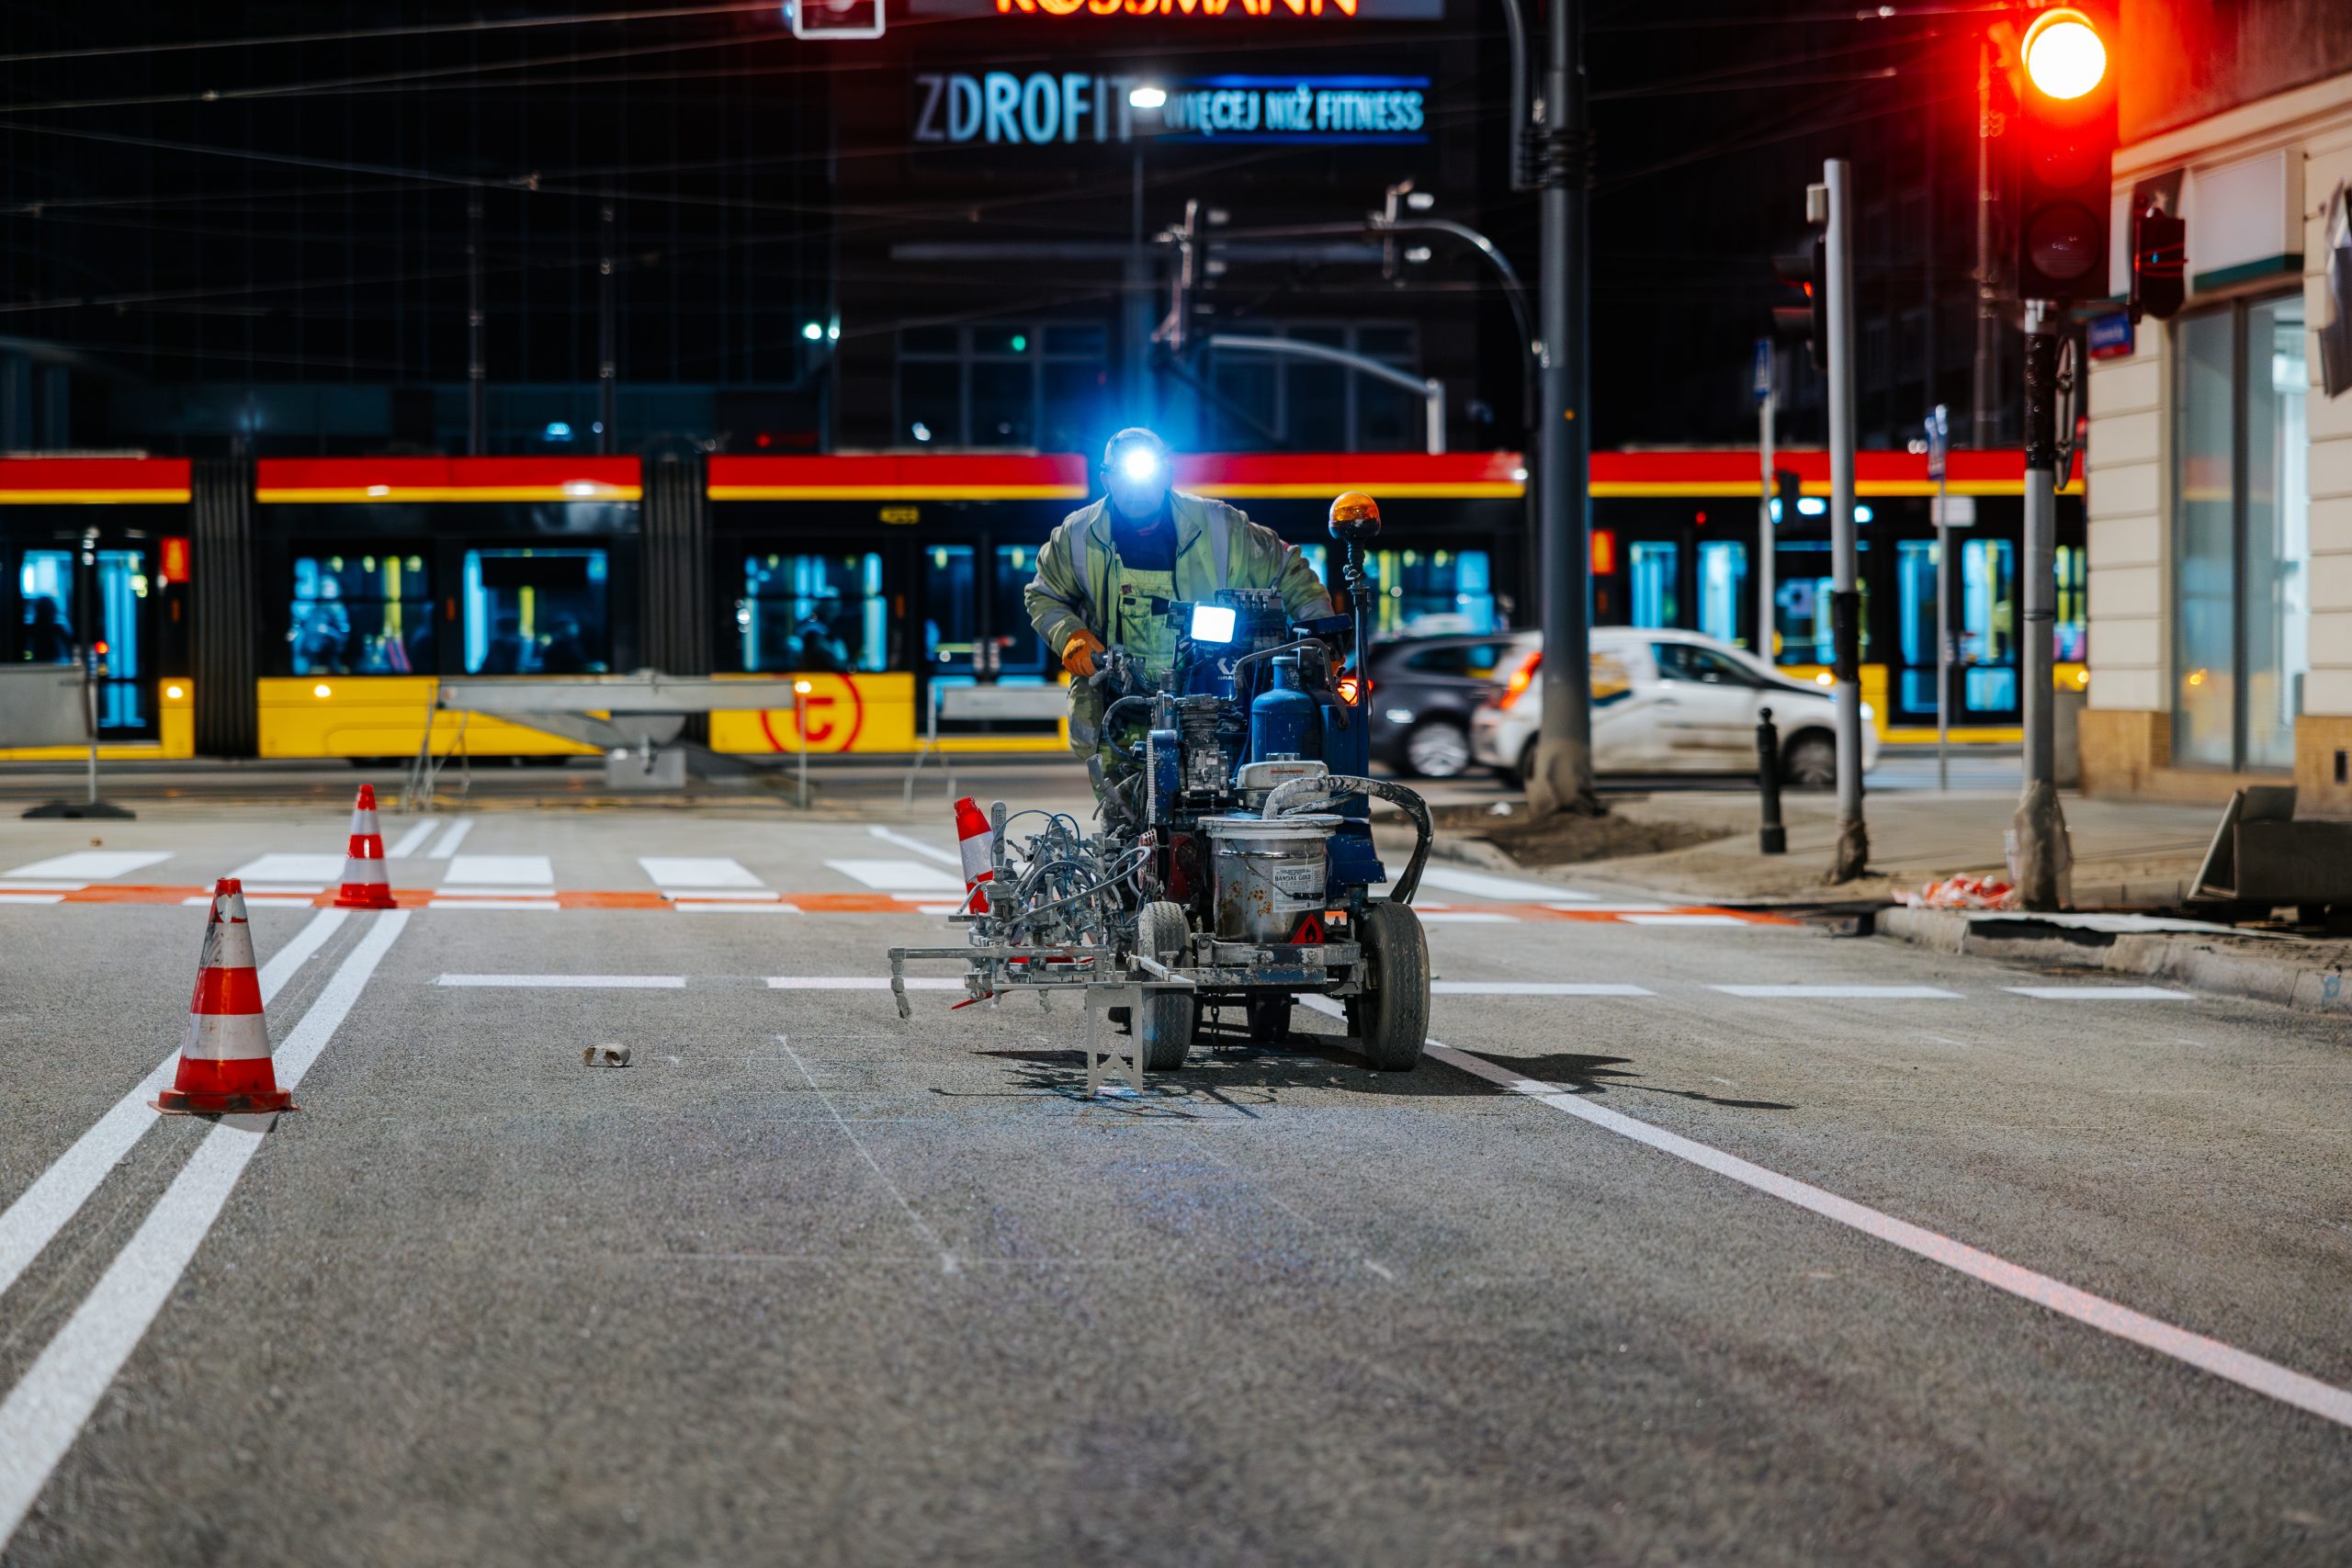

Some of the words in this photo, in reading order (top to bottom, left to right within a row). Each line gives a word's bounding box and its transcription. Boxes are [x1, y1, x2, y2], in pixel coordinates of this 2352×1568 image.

[914, 72, 1139, 144] ZDROFIT
[1162, 91, 1261, 136] WIĘCEJ
[1266, 82, 1312, 130] NIŻ
[1315, 91, 1423, 130] FITNESS
